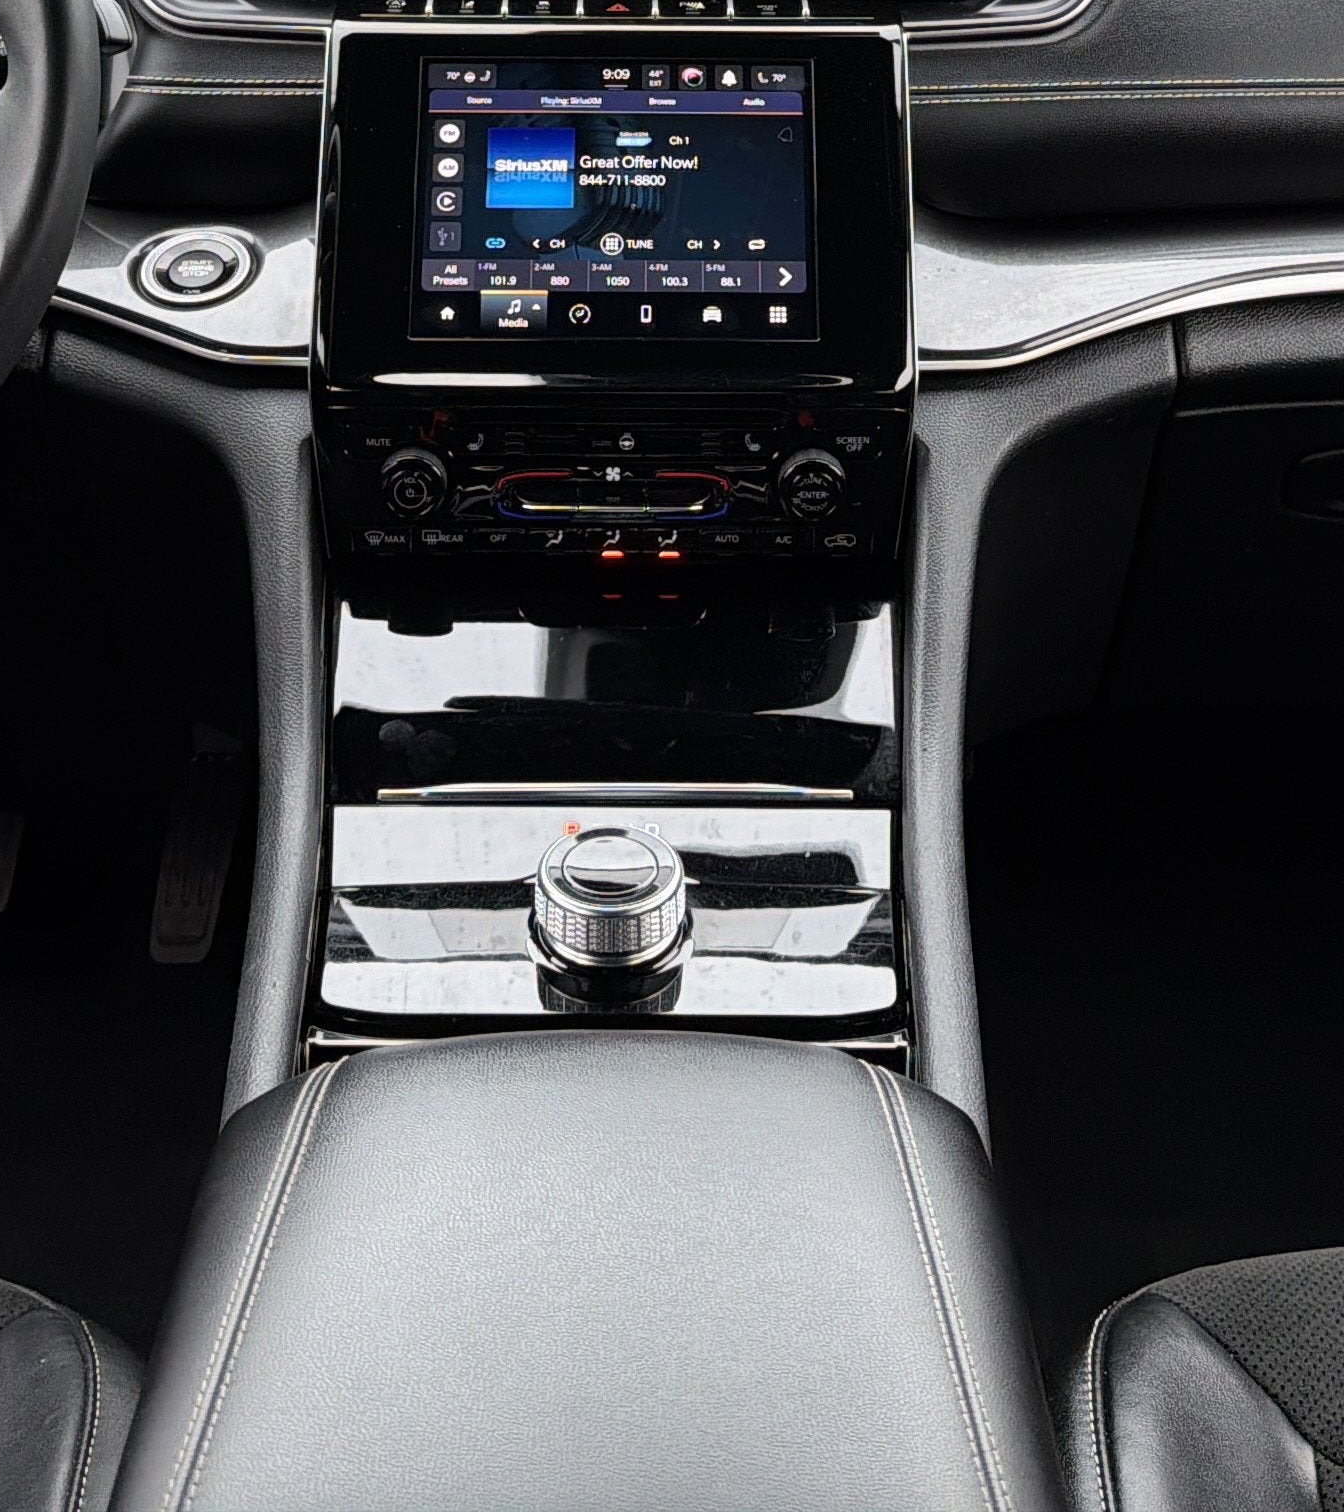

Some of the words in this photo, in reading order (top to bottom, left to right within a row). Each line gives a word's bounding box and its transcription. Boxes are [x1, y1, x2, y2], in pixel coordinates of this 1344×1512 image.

[602, 68, 631, 80] 9:09
[467, 96, 492, 104] Source
[648, 97, 676, 105] Browse
[743, 98, 765, 106] Audio
[669, 136, 683, 145] Ch
[495, 159, 568, 172] SiriusXM
[579, 156, 619, 169] Great
[622, 155, 658, 169] Offer
[661, 156, 698, 169] Now!
[579, 174, 666, 186] 844-711-8800
[550, 239, 565, 249] CH
[626, 239, 654, 249] TUNE
[687, 240, 703, 250] CH
[444, 265, 457, 274] All
[478, 263, 497, 271] 1-FM
[534, 263, 555, 271] 2-AM
[591, 263, 612, 271] 3-AM
[649, 264, 668, 272] 4-FM
[706, 264, 725, 272] 5-FM
[433, 276, 468, 286] Presets
[490, 276, 516, 286] 101.9
[550, 276, 569, 286] 880
[606, 276, 630, 286] 1050
[662, 277, 688, 286] 100.3
[721, 277, 741, 286] 88.1
[498, 318, 528, 328] Media
[366, 438, 391, 447] MUTE
[836, 437, 870, 445] SCREEN
[846, 444, 863, 452] OFF
[800, 491, 827, 499] ENTER
[385, 534, 405, 543] MAX
[442, 534, 463, 543] REAR
[490, 534, 507, 543] OFF
[715, 535, 739, 543] AUTO
[775, 536, 792, 544] A/C
